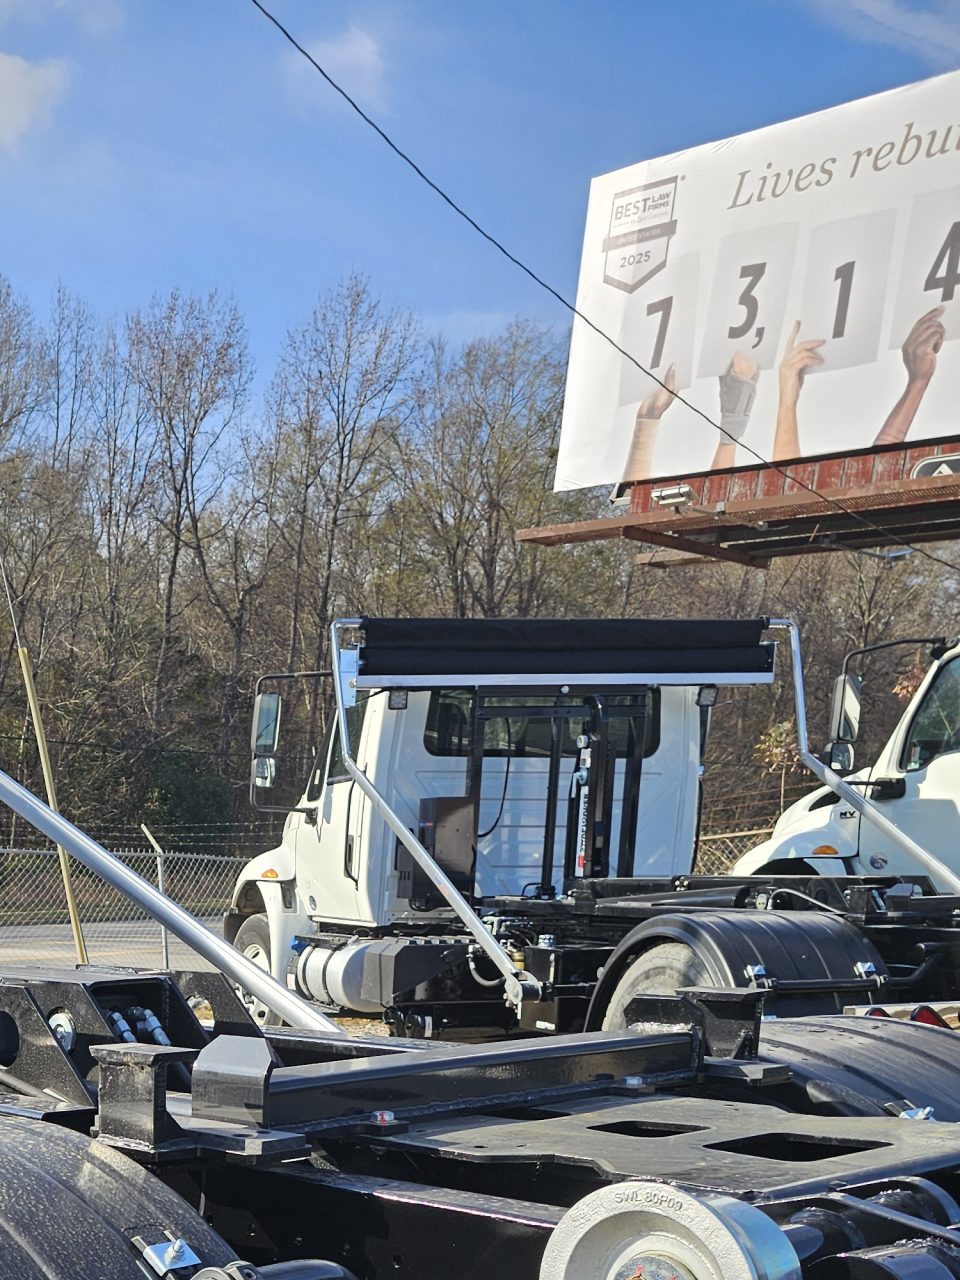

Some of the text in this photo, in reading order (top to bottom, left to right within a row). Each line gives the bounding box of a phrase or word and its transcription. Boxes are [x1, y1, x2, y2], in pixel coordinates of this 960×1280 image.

[727, 157, 837, 209] Lives
[647, 200, 670, 212] FIRMS
[652, 191, 672, 203] LAW
[614, 197, 651, 221] BEST
[619, 250, 651, 268] 2025
[646, 295, 674, 370] 7
[831, 261, 856, 339] 1
[923, 221, 960, 302] 4
